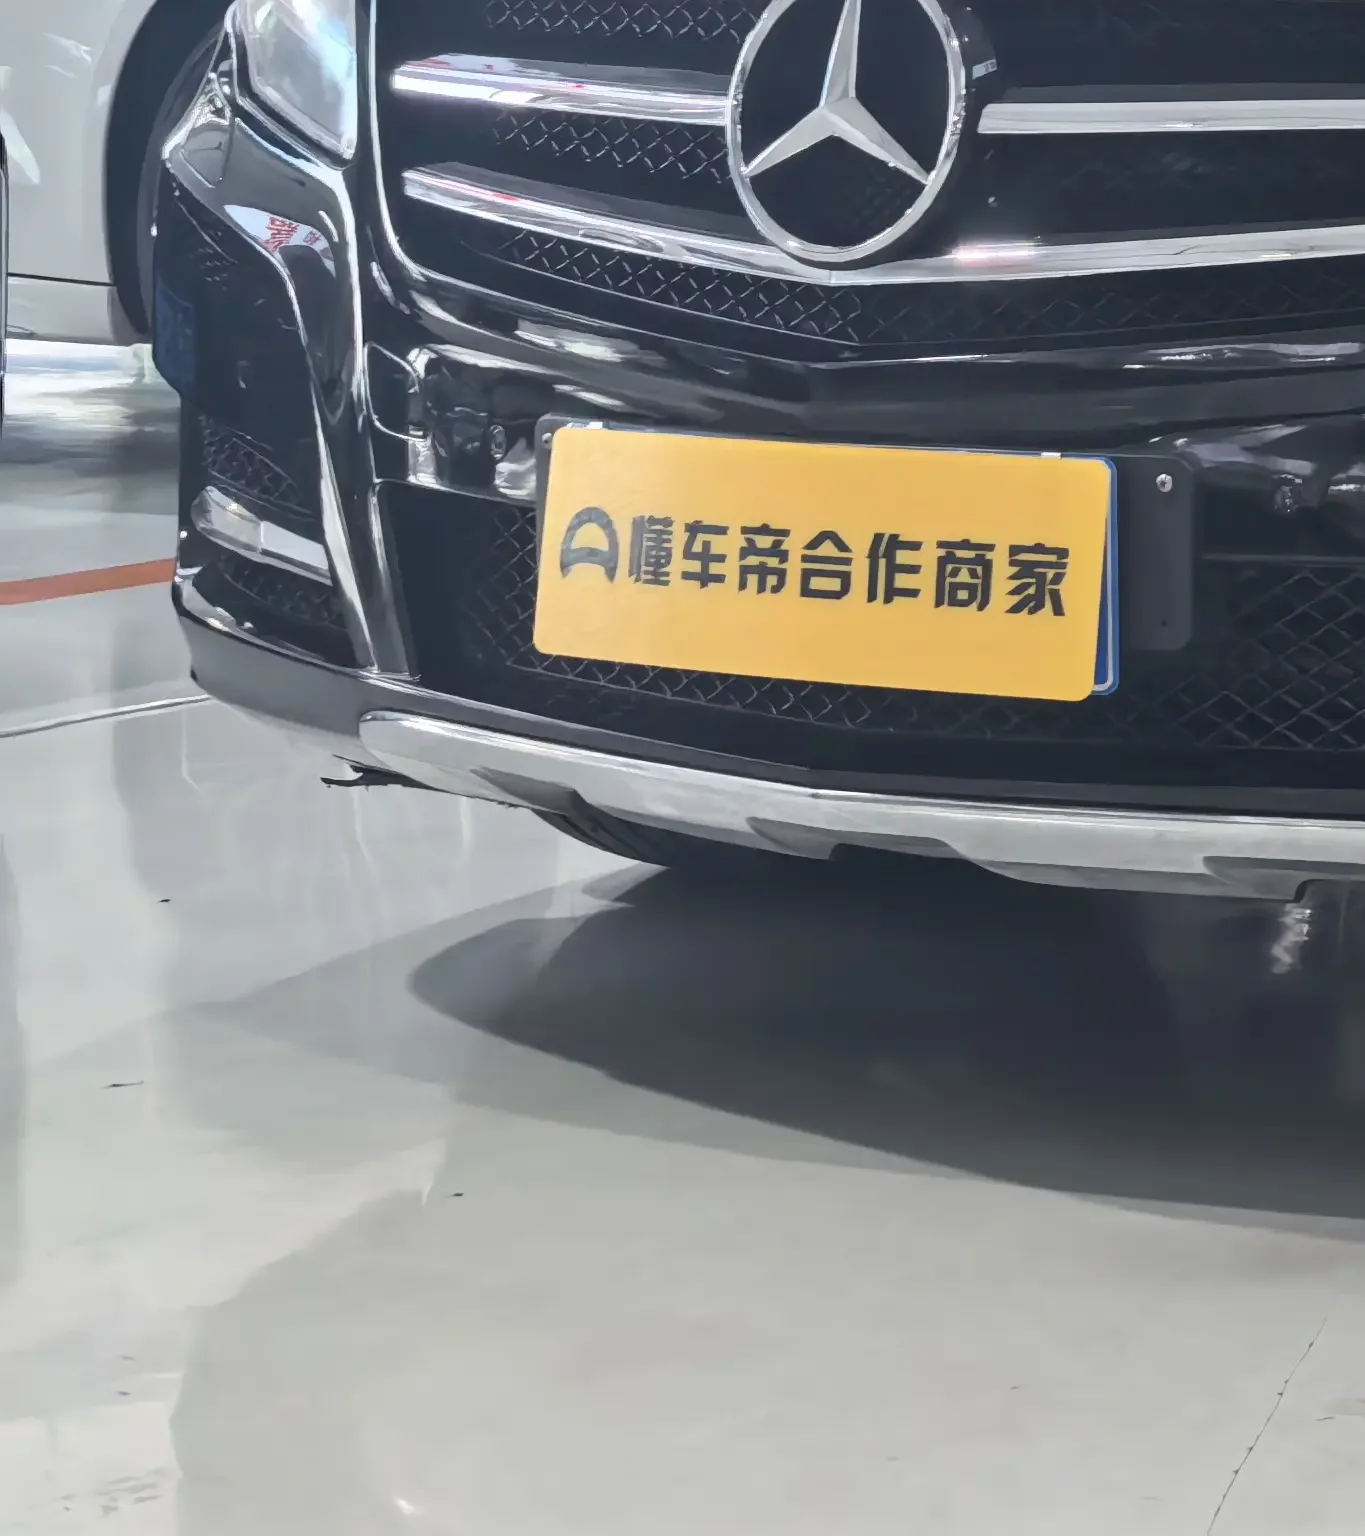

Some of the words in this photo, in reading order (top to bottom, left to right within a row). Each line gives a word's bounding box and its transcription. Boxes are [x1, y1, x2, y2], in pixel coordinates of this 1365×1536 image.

[628, 514, 1071, 617] 懂车帝合作商家
